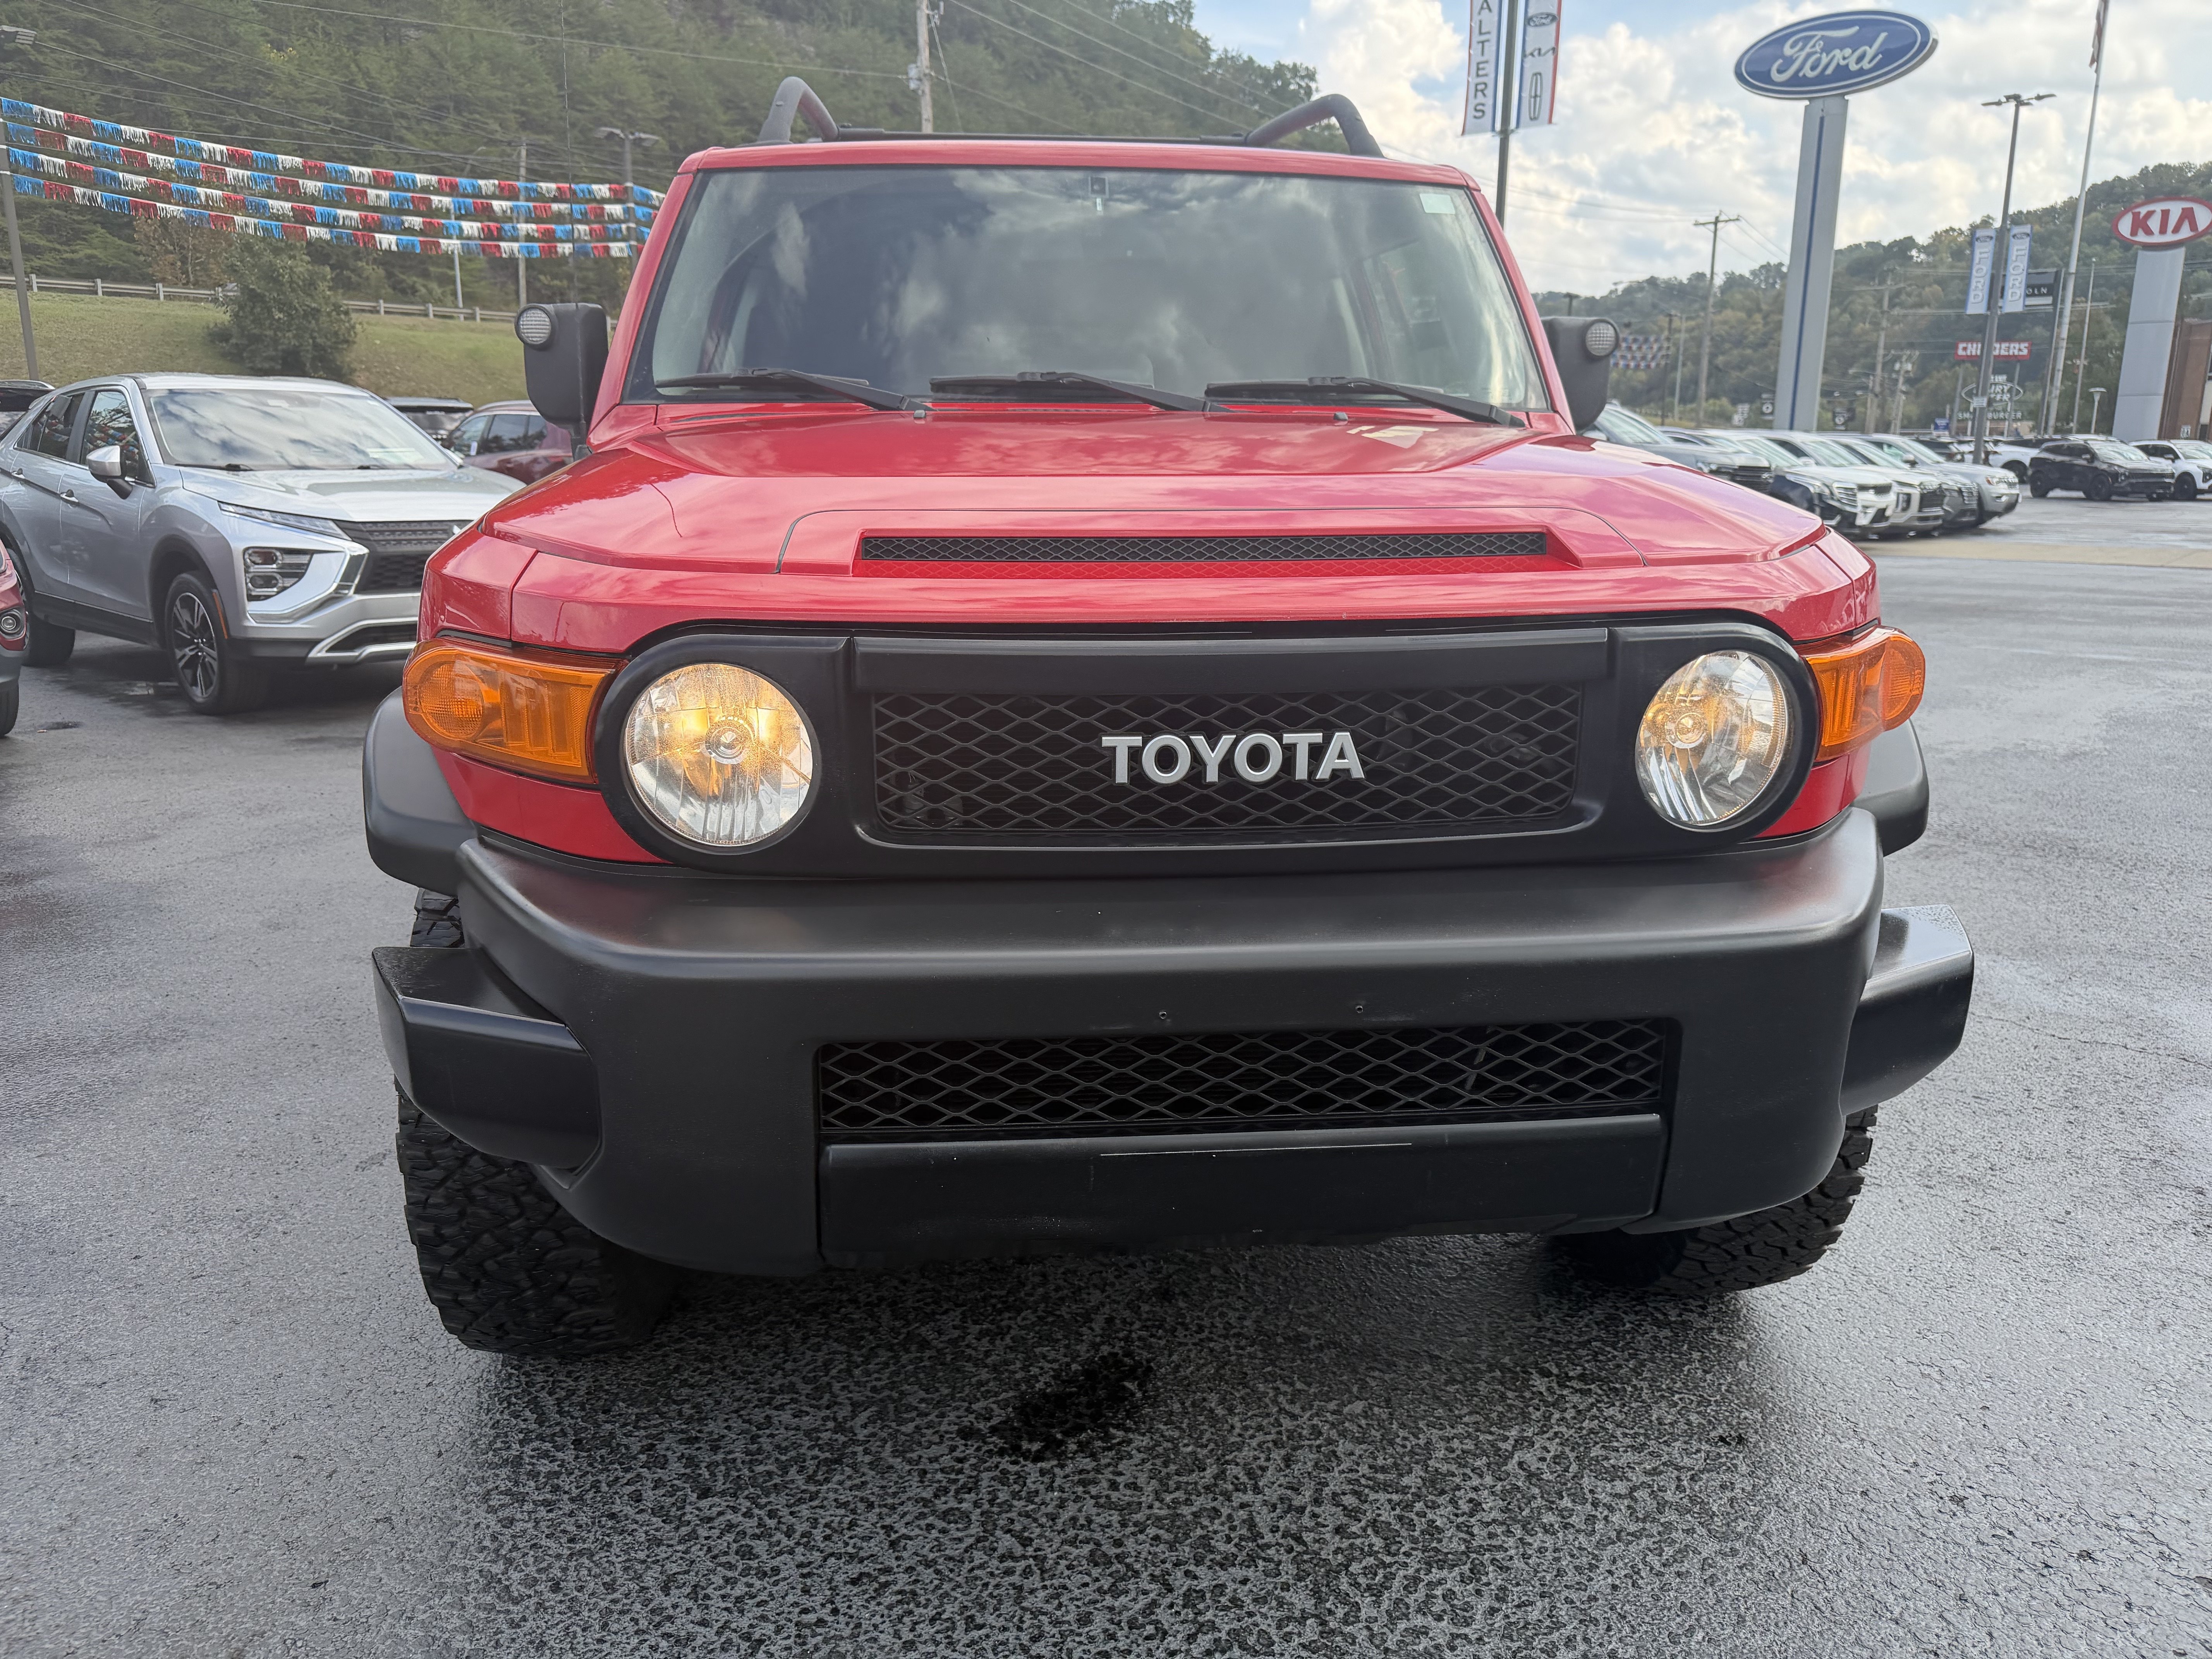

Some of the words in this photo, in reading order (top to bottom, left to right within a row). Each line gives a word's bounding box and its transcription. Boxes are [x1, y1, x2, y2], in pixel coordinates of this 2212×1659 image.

[1771, 26, 1888, 82] Ford
[2130, 207, 2199, 237] KIA
[1971, 250, 1990, 304] FORD
[2009, 247, 2028, 302] FORD
[1957, 342, 2028, 356] CHIDERS
[1102, 732, 1365, 785] TOYOTA
